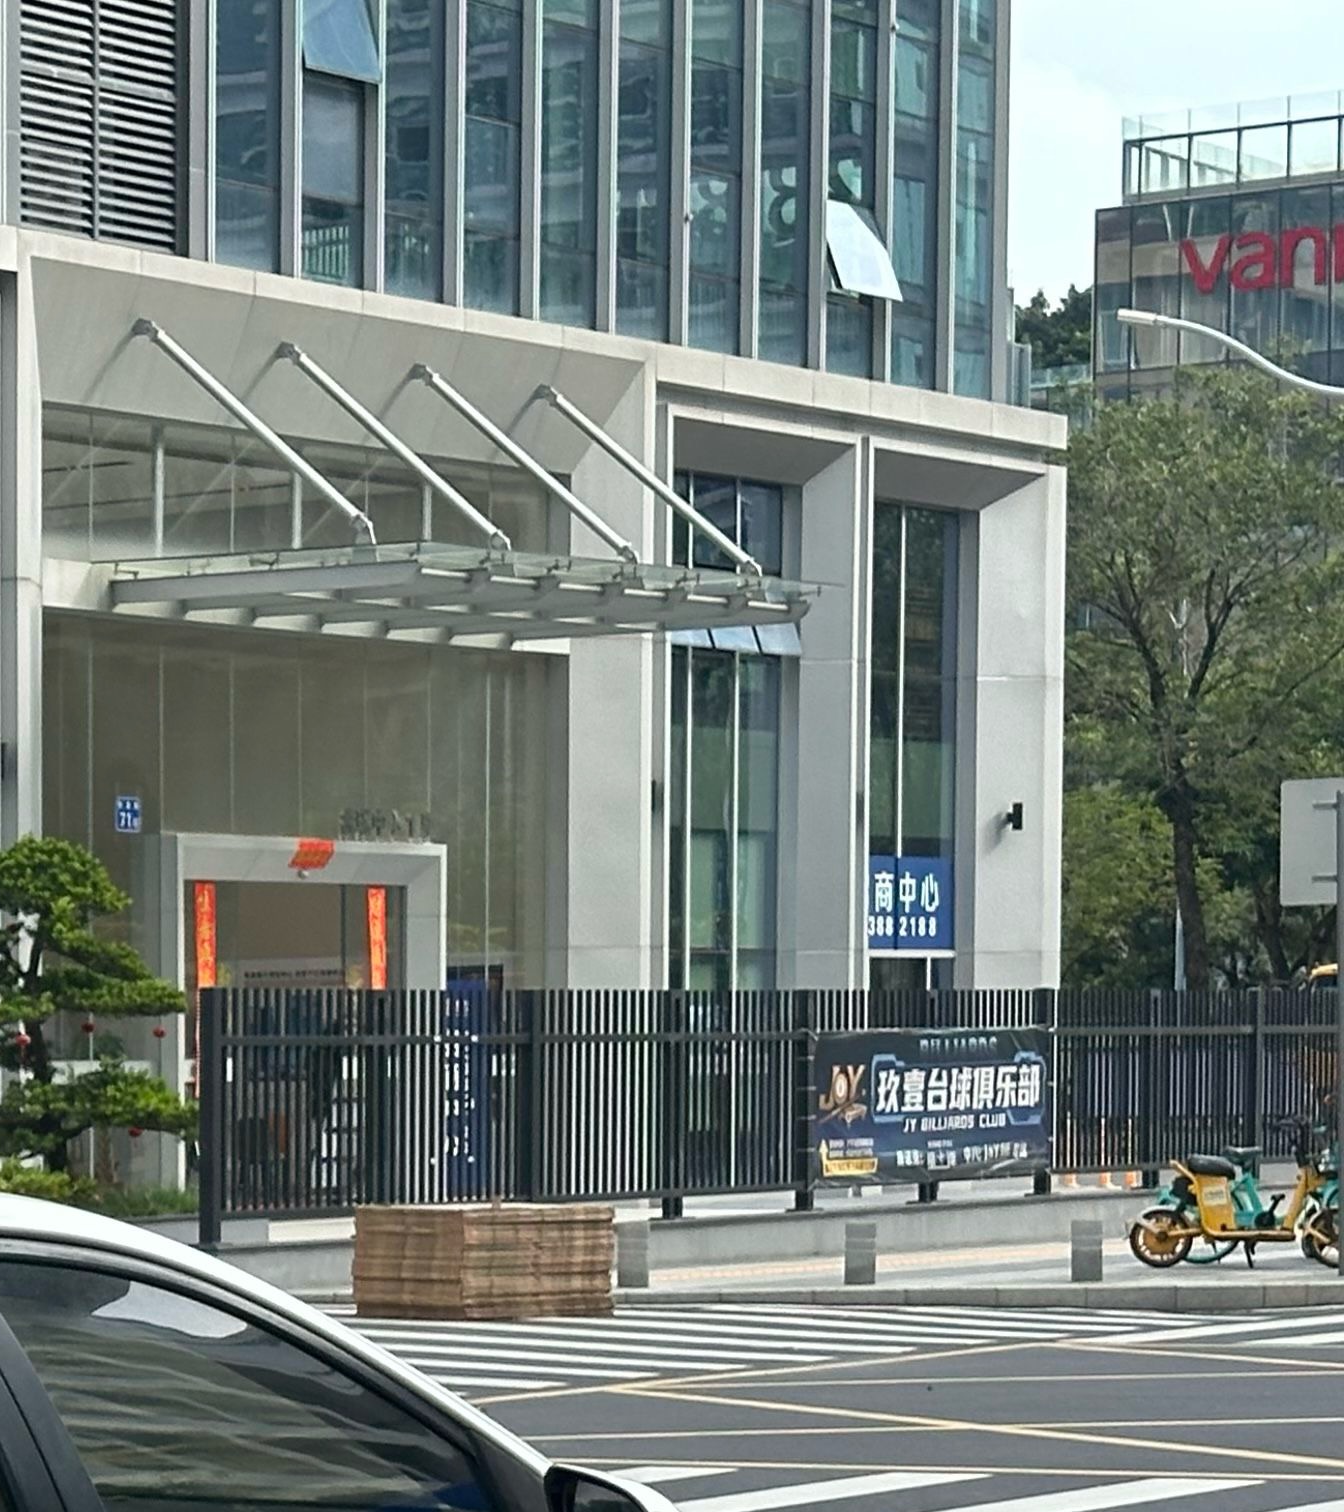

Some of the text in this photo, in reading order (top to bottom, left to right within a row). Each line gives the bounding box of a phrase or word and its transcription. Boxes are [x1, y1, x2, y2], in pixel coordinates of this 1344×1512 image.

[875, 1064, 1041, 1113] 玖壹台球俱乐部
[903, 1112, 1007, 1133] JY BILLIARDS CLUB
